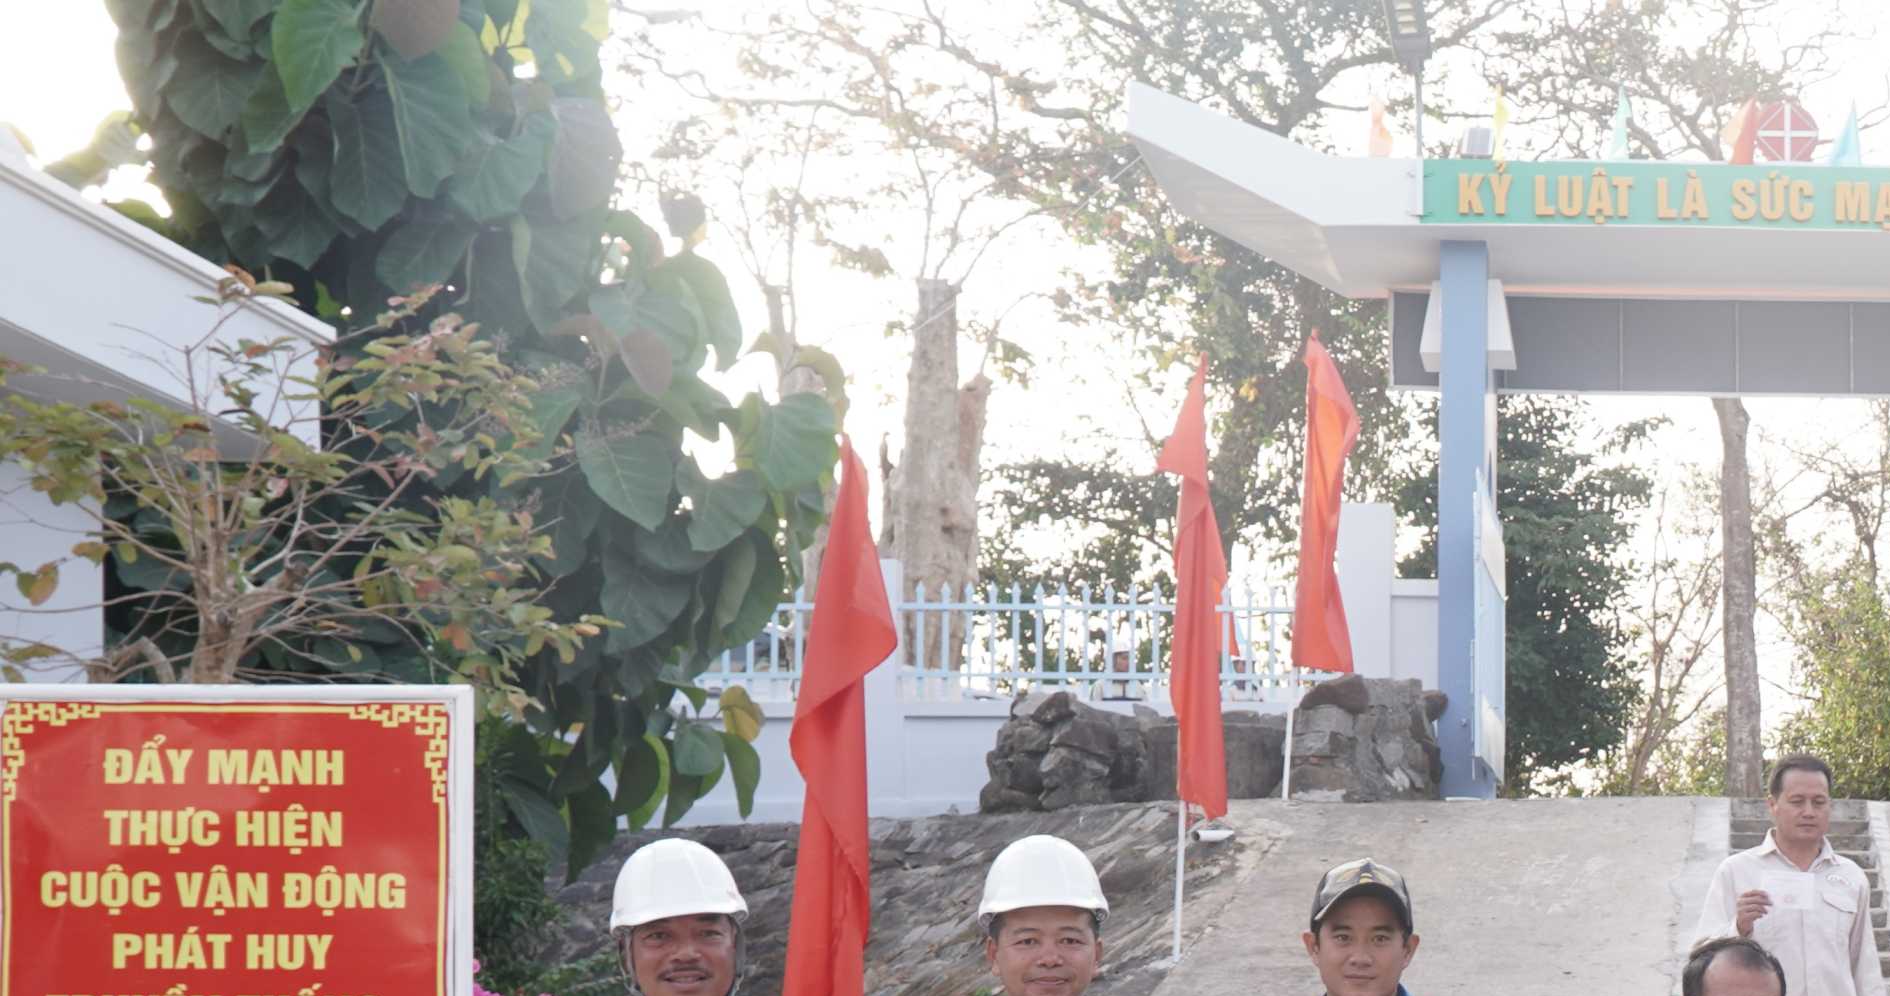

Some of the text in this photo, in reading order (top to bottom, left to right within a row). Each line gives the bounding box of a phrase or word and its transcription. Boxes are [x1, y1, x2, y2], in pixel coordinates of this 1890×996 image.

[1457, 160, 1513, 217] KỶ
[1534, 165, 1634, 224] LUẬT
[1656, 168, 1710, 220] LÀ
[1731, 170, 1815, 222] SỨC
[103, 734, 344, 793] ĐẨY MẠNH
[104, 804, 342, 854] THỰC HIỆN
[41, 864, 407, 916] CUỘC VẬN ĐỘNG
[113, 927, 333, 970] PHÁT HUY
